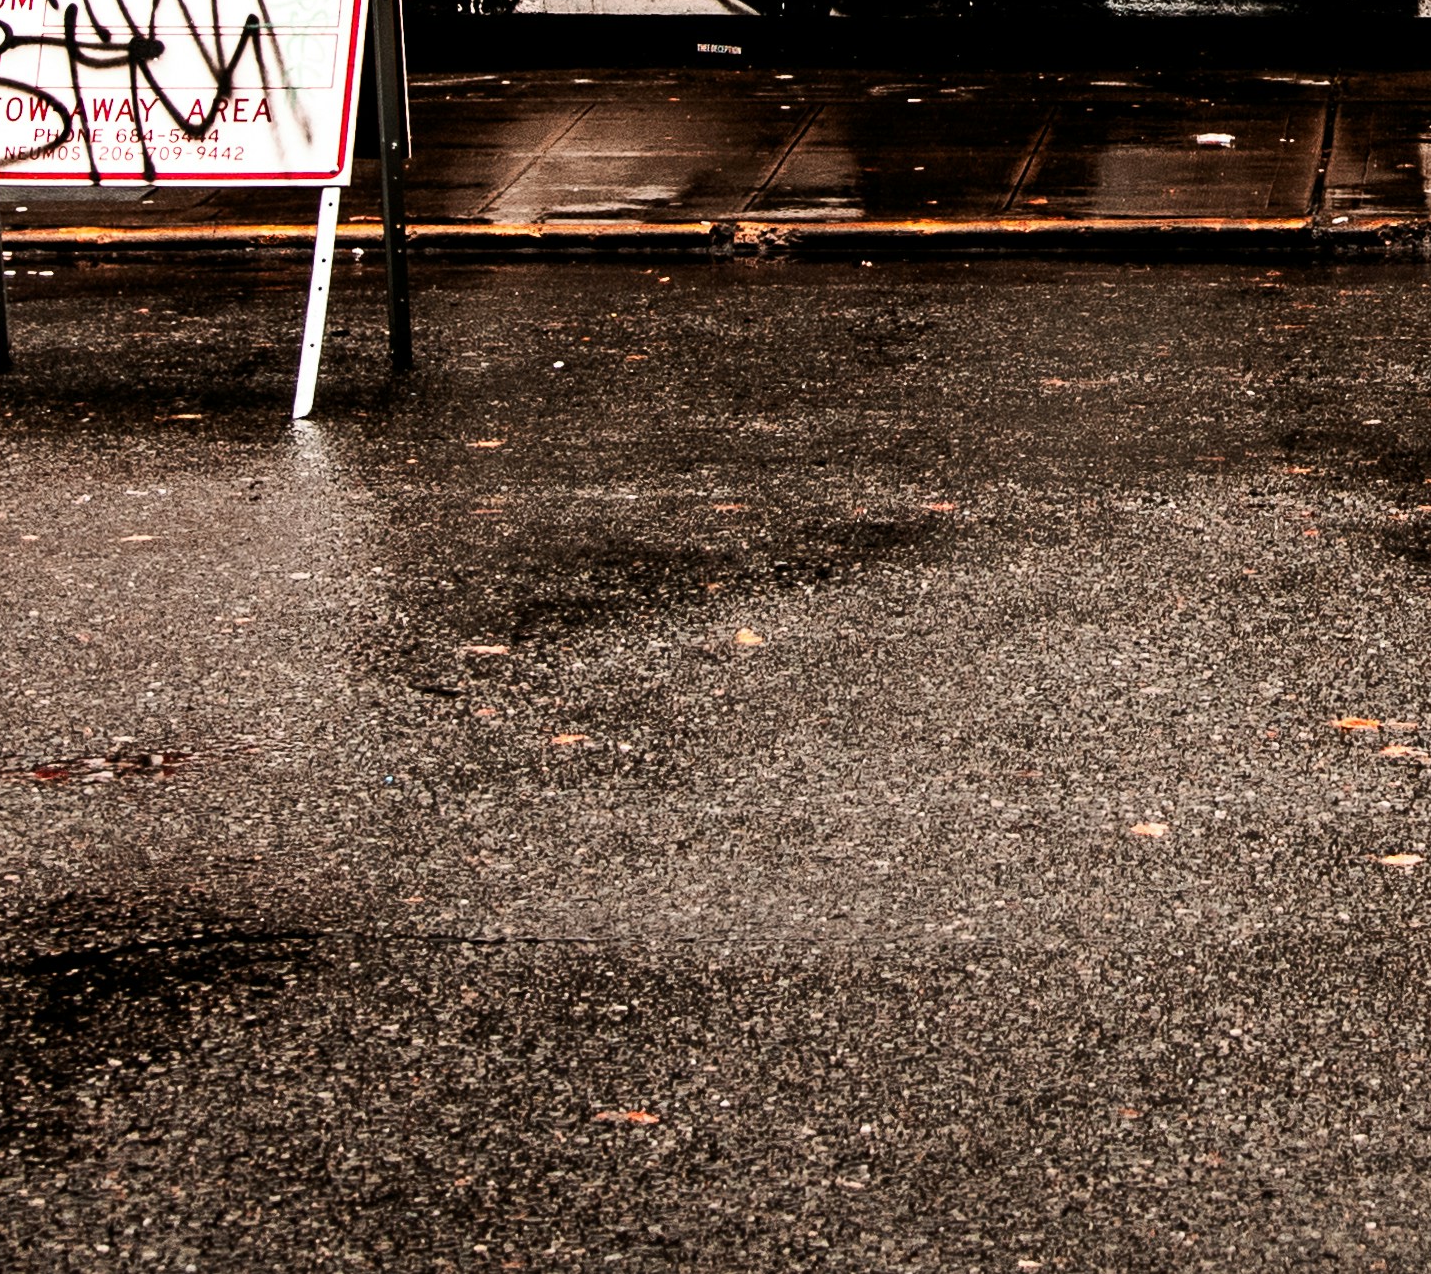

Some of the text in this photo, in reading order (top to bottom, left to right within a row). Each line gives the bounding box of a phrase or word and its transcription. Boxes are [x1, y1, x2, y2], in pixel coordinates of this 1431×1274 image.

[190, 96, 273, 124] AREA
[32, 126, 221, 146] PHONE 684-5444
[4, 145, 246, 163] NEUMOS 206-709-9442
